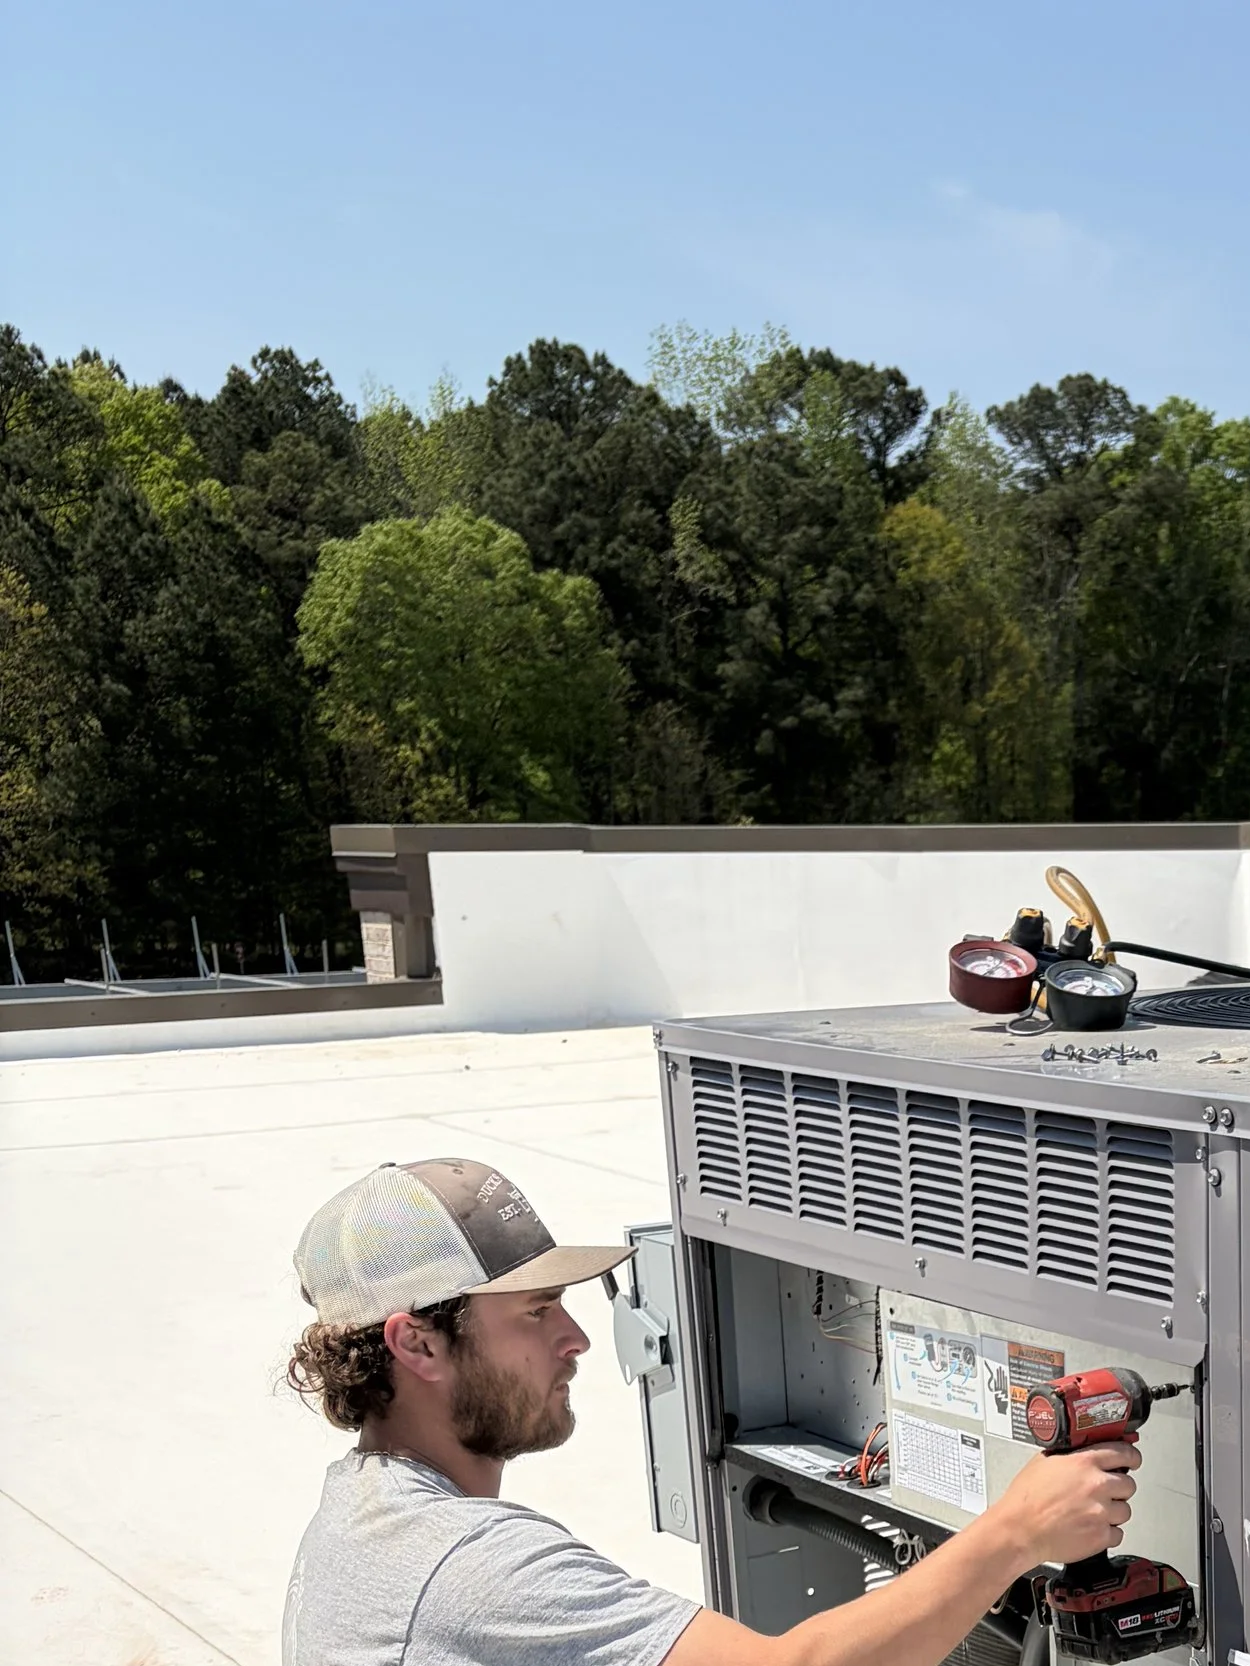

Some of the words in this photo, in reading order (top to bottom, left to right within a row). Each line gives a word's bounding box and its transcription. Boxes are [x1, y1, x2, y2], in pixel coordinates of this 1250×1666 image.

[477, 1173, 503, 1204] DUCKS
[498, 1203, 521, 1220] EST.
[1120, 1616, 1139, 1628] M18
